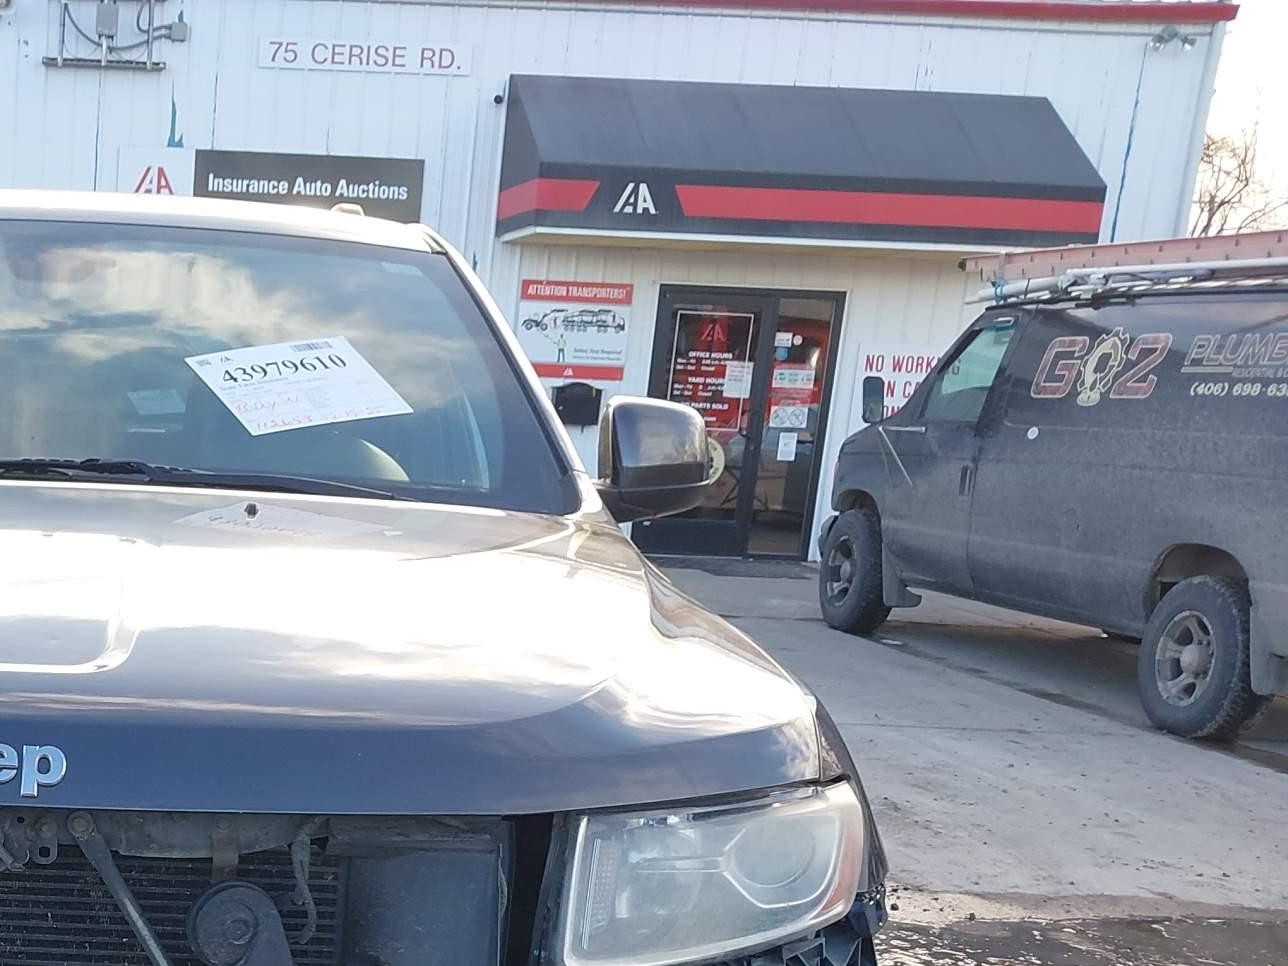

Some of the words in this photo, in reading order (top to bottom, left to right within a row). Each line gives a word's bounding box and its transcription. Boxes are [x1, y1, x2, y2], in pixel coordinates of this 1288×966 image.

[269, 41, 298, 63] 75
[311, 42, 407, 68] CERISE
[419, 47, 462, 70] RD.
[208, 173, 288, 195] Insurance
[292, 176, 331, 198] Auto
[335, 179, 409, 201] Auctions
[527, 284, 567, 297] ATTENTION
[711, 351, 733, 359] HOURS
[864, 354, 885, 372] NO
[222, 353, 347, 384] 43979610
[1190, 382, 1229, 397] (406)
